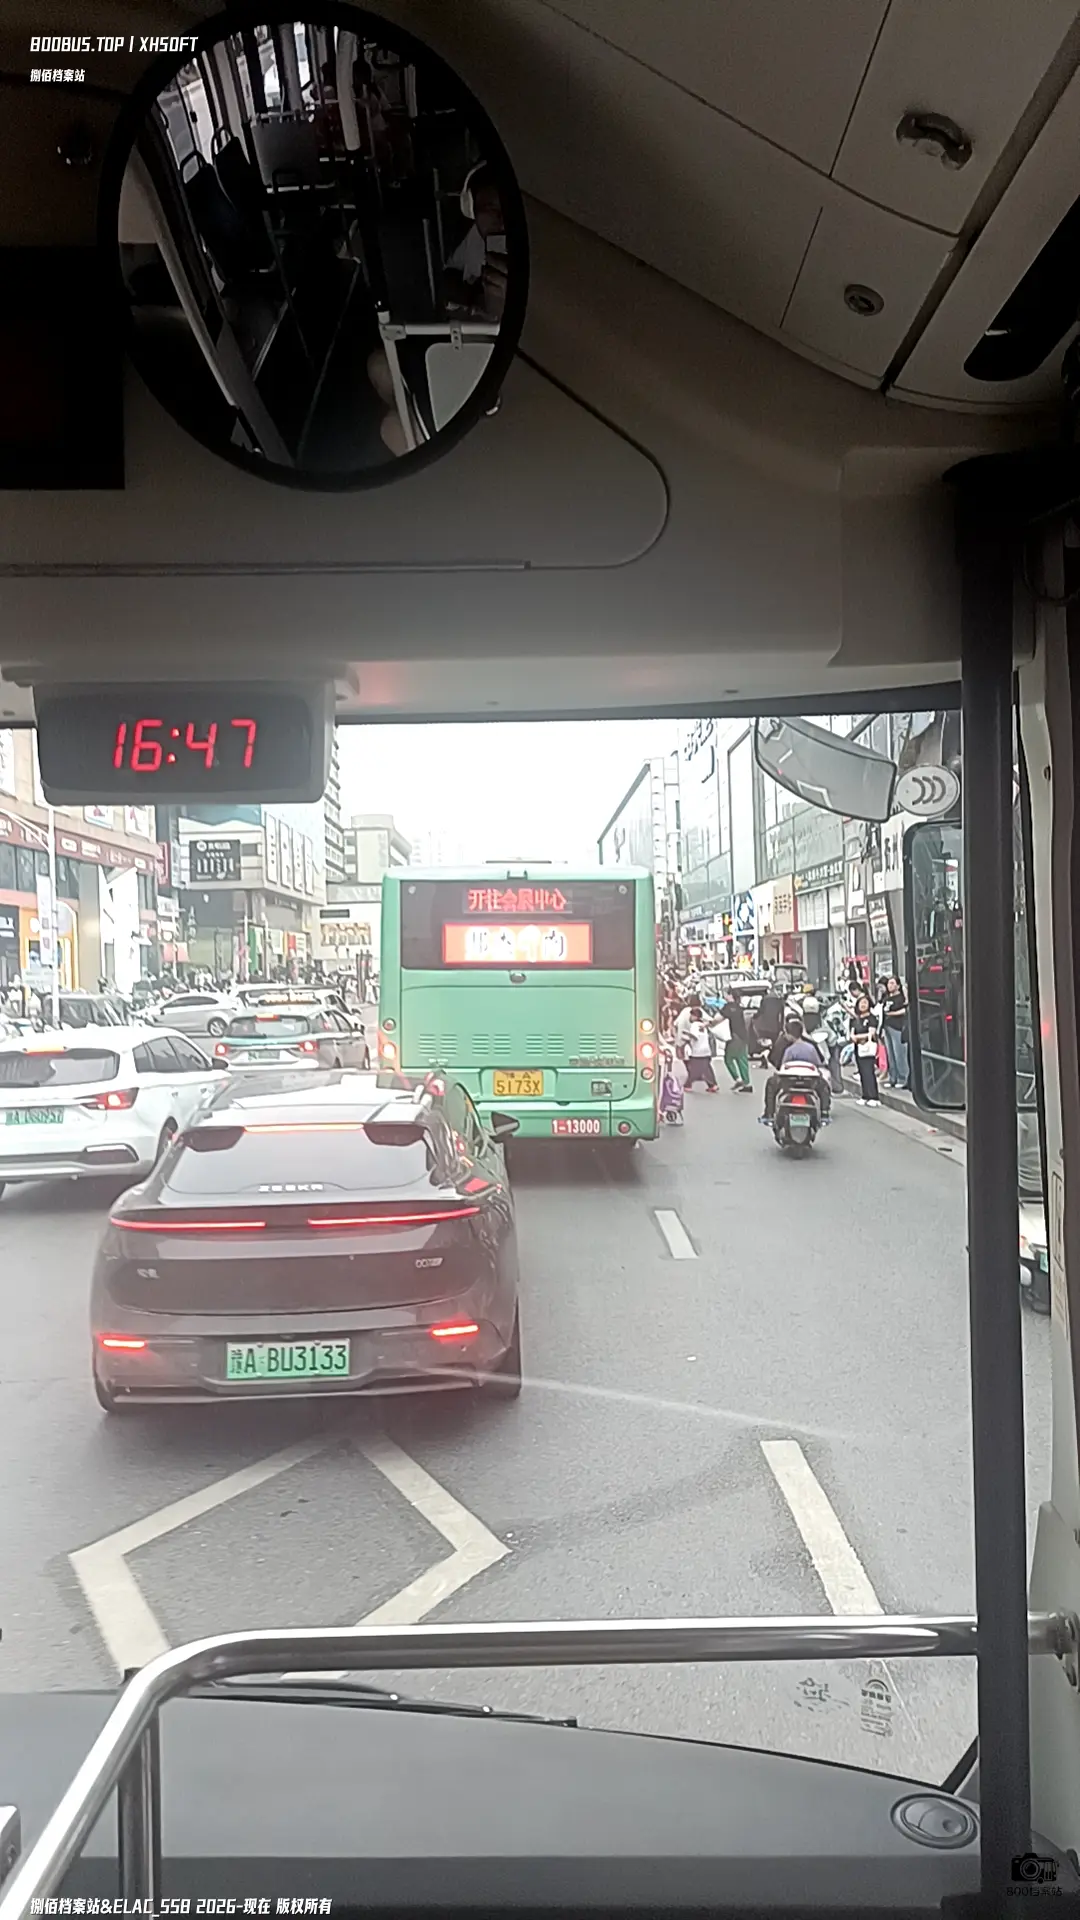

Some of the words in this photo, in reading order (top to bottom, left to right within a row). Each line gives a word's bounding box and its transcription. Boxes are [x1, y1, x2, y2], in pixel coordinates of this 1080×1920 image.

[113, 718, 257, 772] 16:47
[467, 887, 567, 912] 开往会展中心
[496, 1079, 541, 1094] 5173X
[552, 1119, 600, 1134] 1-13000
